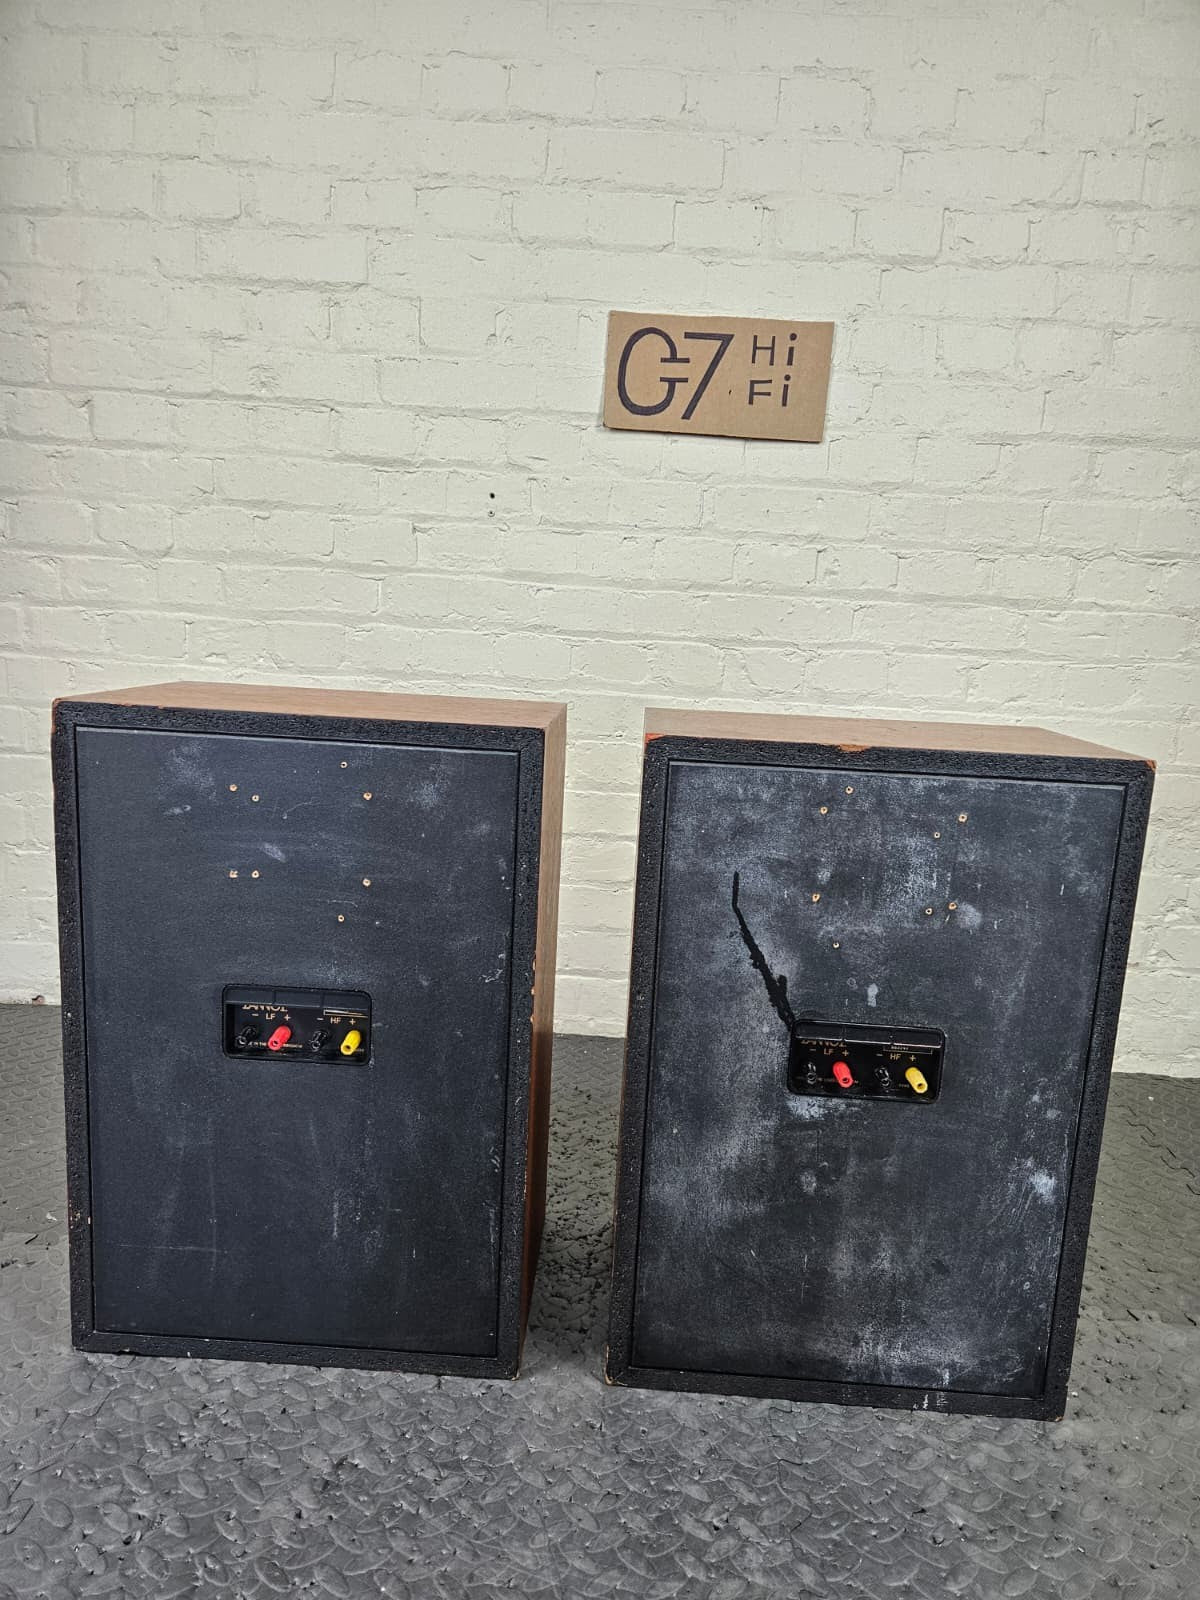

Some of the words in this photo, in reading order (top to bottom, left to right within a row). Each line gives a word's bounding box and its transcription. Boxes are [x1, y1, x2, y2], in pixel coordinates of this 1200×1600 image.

[751, 332, 797, 366] Hi
[617, 326, 735, 420] G7
[748, 374, 791, 407] Fi
